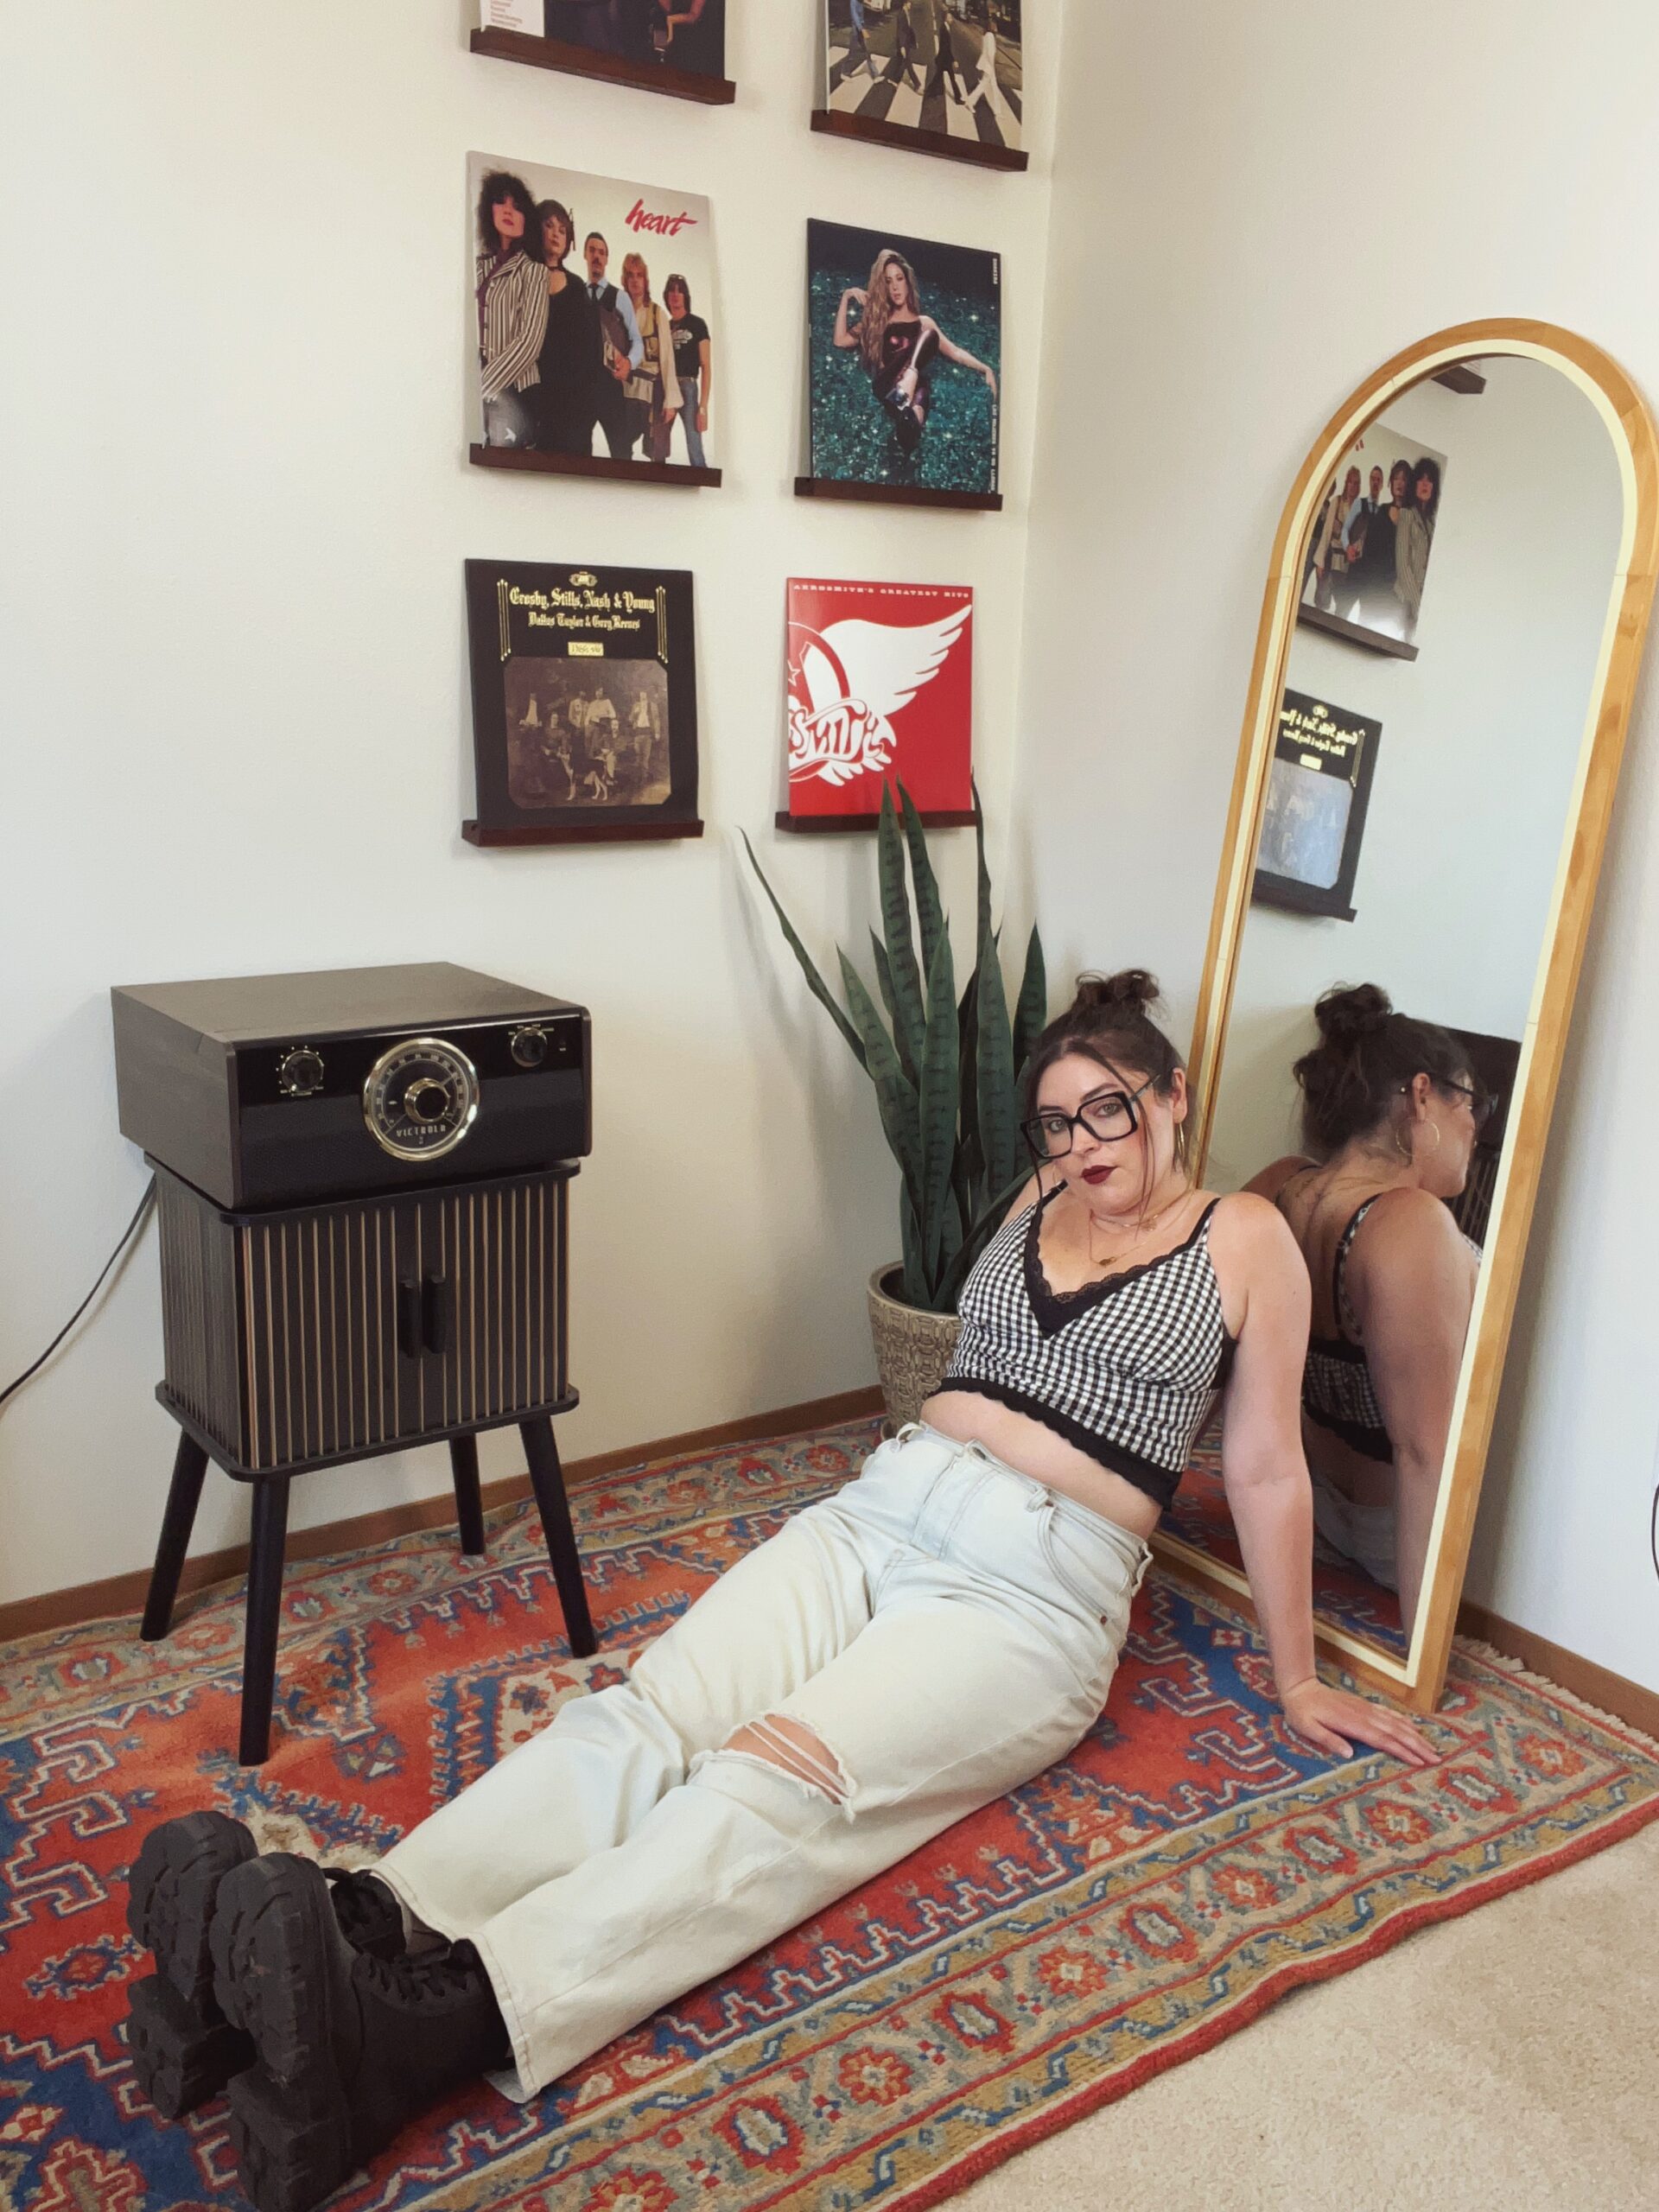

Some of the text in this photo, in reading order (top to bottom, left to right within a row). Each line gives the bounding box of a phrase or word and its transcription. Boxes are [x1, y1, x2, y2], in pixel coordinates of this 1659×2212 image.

[625, 198, 698, 237] heart
[509, 586, 656, 613] Crosby, Stills, Nash & Young
[793, 584, 874, 594] AEROSMITH'S
[880, 588, 938, 597] GREATEST
[396, 1123, 446, 1138] VICTROLA
